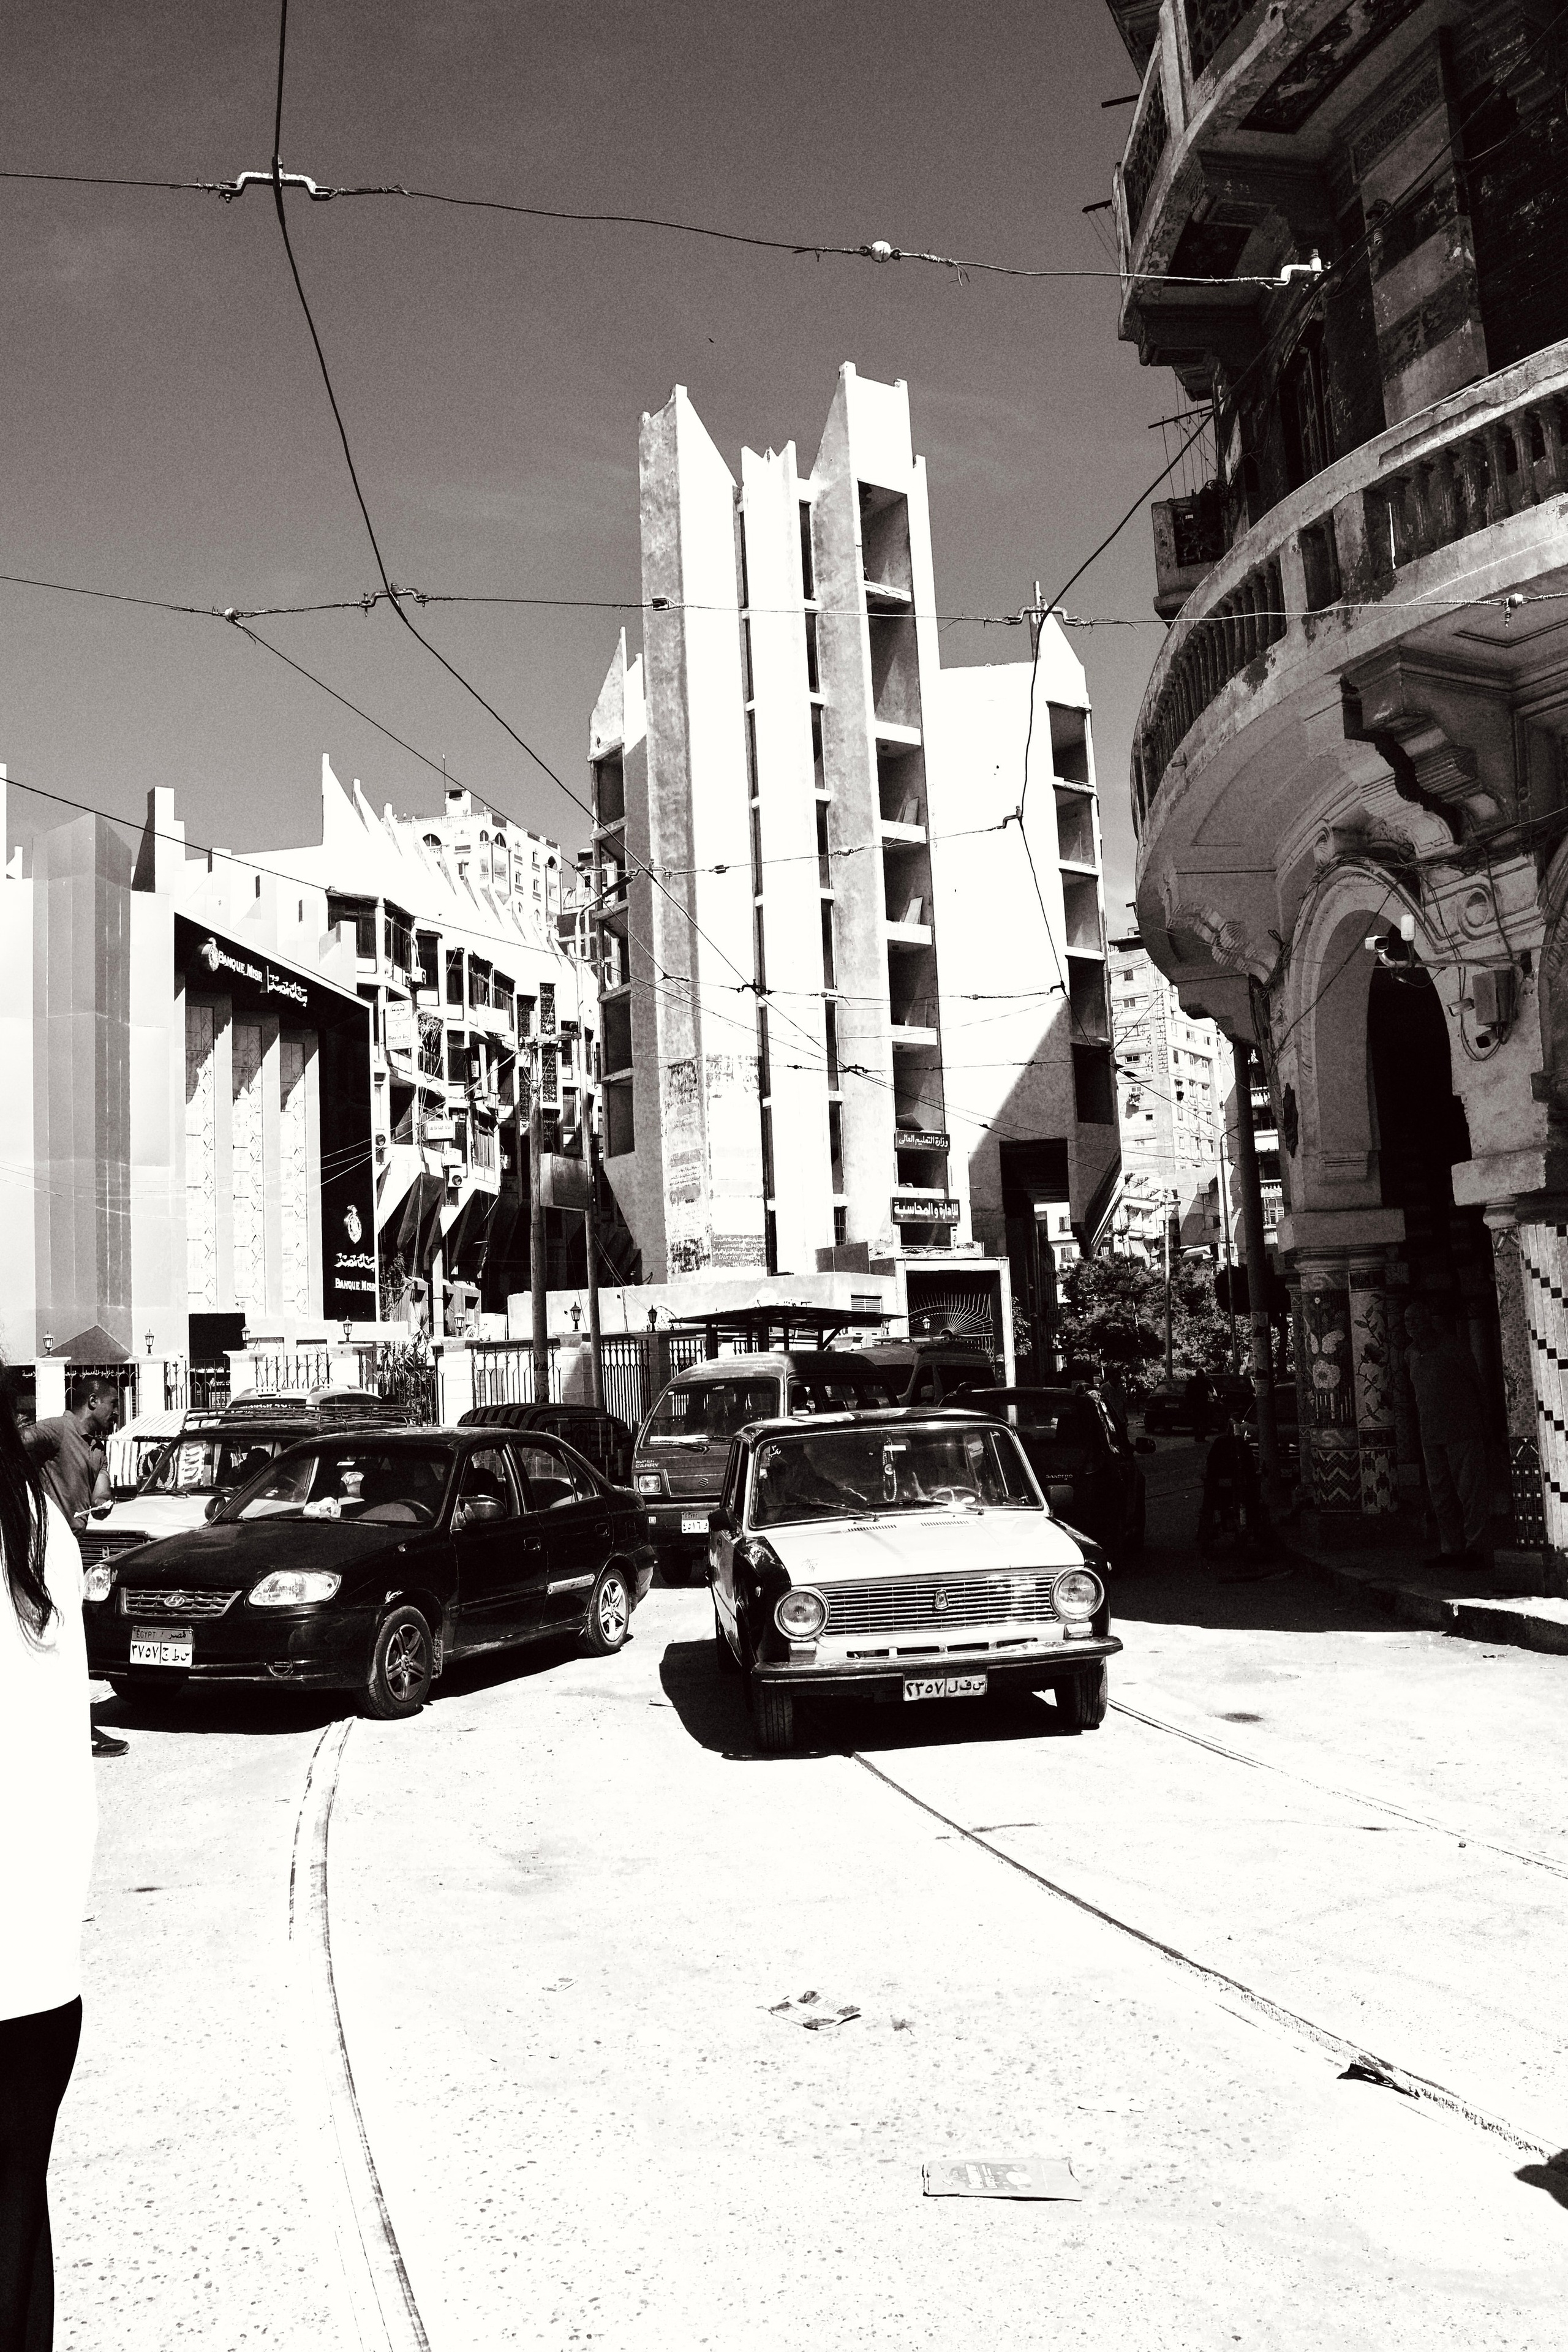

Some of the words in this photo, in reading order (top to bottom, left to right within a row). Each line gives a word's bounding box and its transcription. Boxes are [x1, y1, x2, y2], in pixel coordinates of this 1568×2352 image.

[915, 1135, 935, 1146] التعليم
[935, 1136, 948, 1147] وزارة
[136, 1630, 156, 1638] EGYPT
[168, 1630, 186, 1640] مصر
[132, 1644, 159, 1659] ٣٧٥٧
